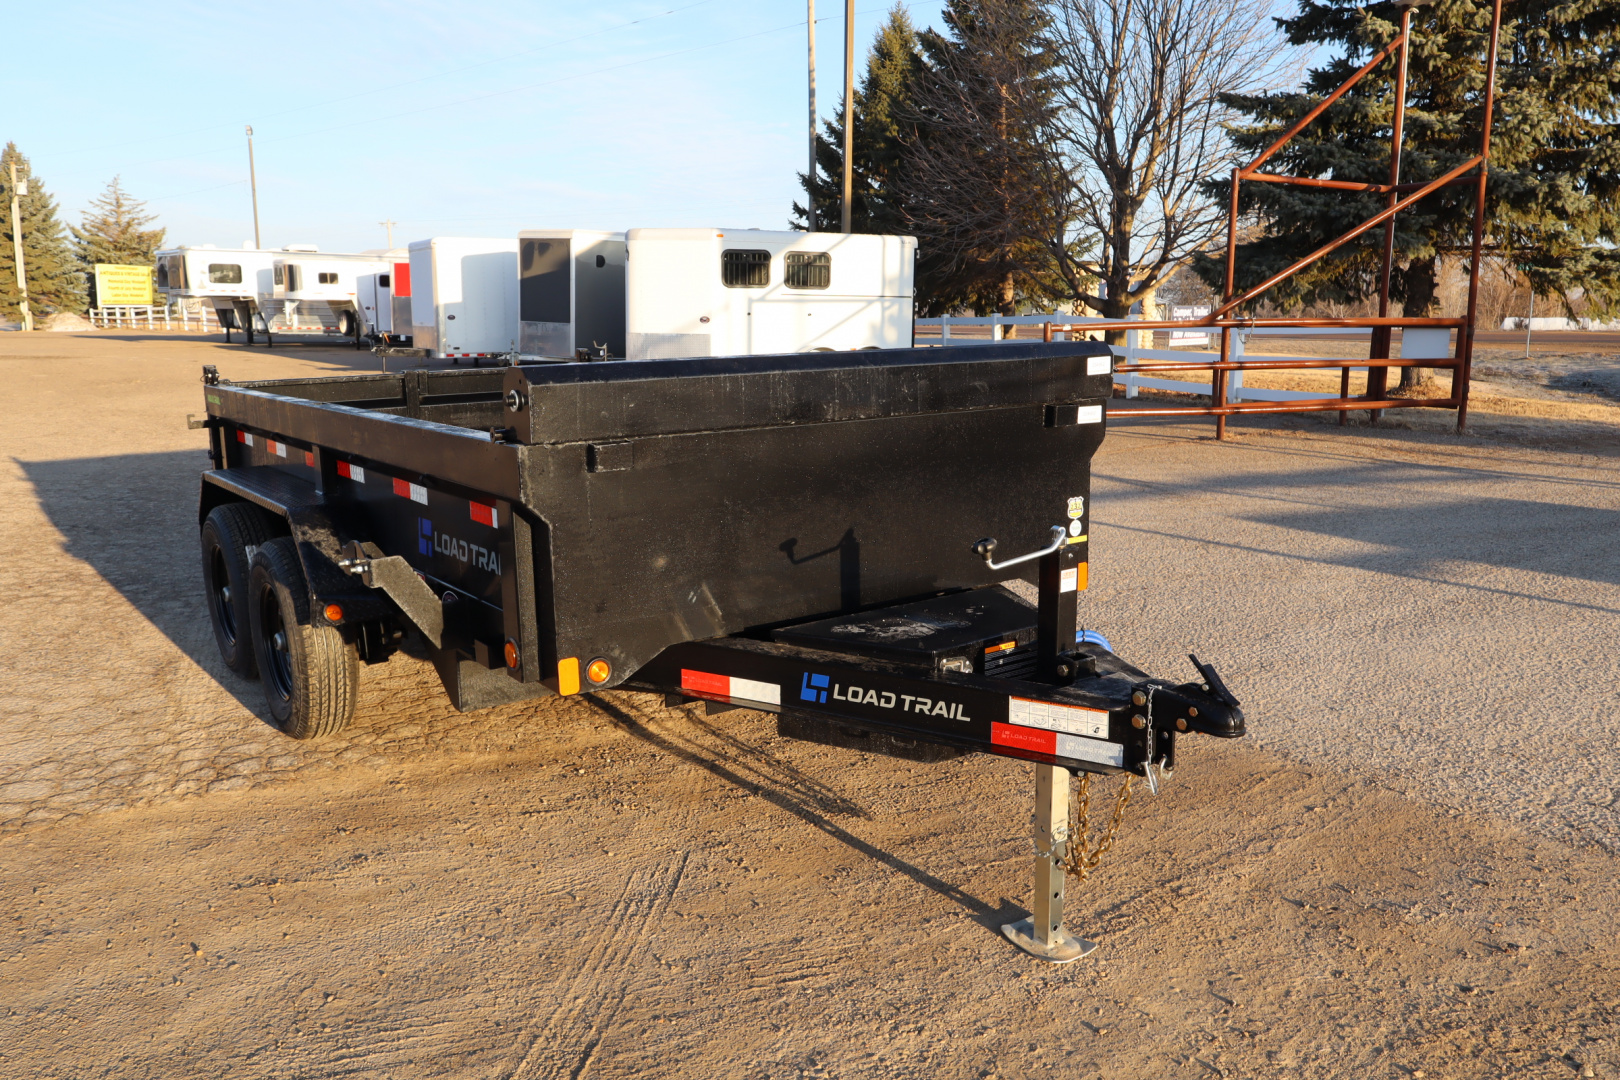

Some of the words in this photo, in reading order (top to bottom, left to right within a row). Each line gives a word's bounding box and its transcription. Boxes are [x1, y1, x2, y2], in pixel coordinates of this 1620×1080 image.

[1173, 307, 1192, 318] Camper,
[1194, 306, 1209, 316] Trailer
[434, 531, 468, 563] LOAD
[469, 543, 501, 576] TRAI
[833, 683, 896, 709] LOAD
[900, 694, 971, 722] TRAIL
[1010, 733, 1029, 741] LOAD
[1028, 736, 1047, 744] TRAIL
